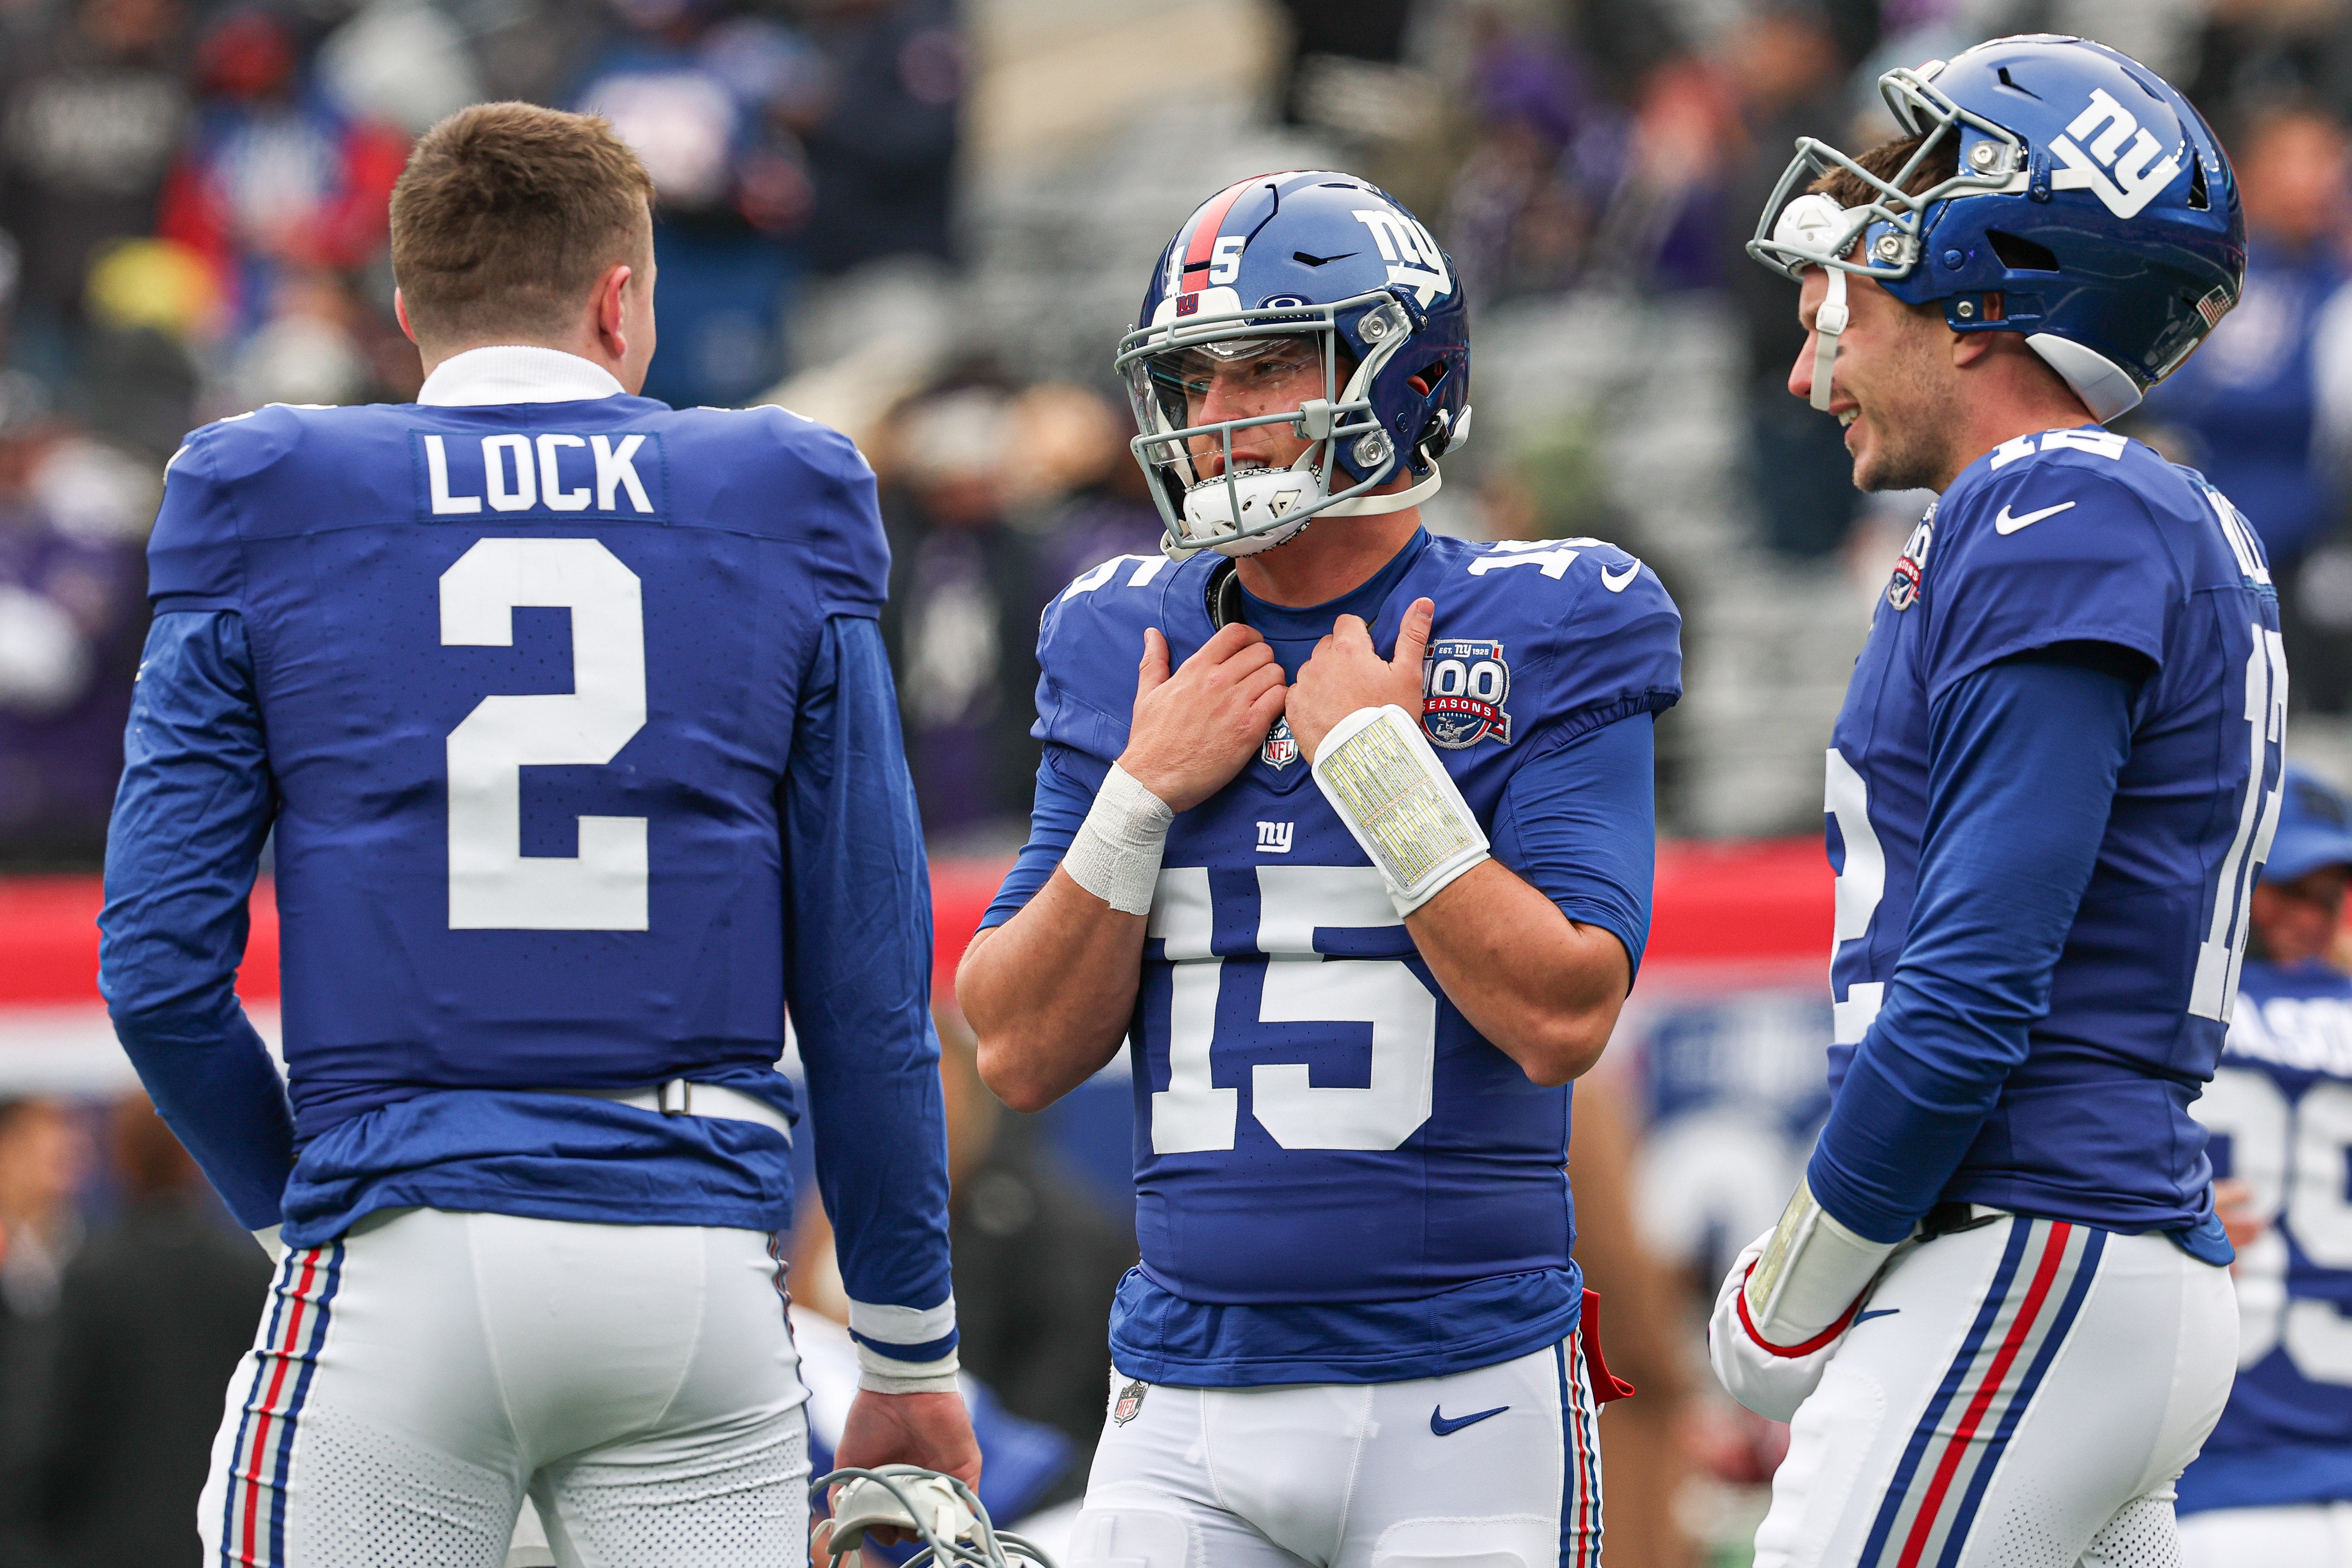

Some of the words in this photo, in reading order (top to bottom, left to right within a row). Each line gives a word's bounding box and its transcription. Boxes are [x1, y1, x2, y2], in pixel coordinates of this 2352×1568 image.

[424, 434, 655, 515] LOCK
[438, 537, 649, 931] 2
[1267, 741, 1292, 761] NFL
[1148, 865, 1437, 1155] 15
[1116, 1398, 1135, 1417] NFL
